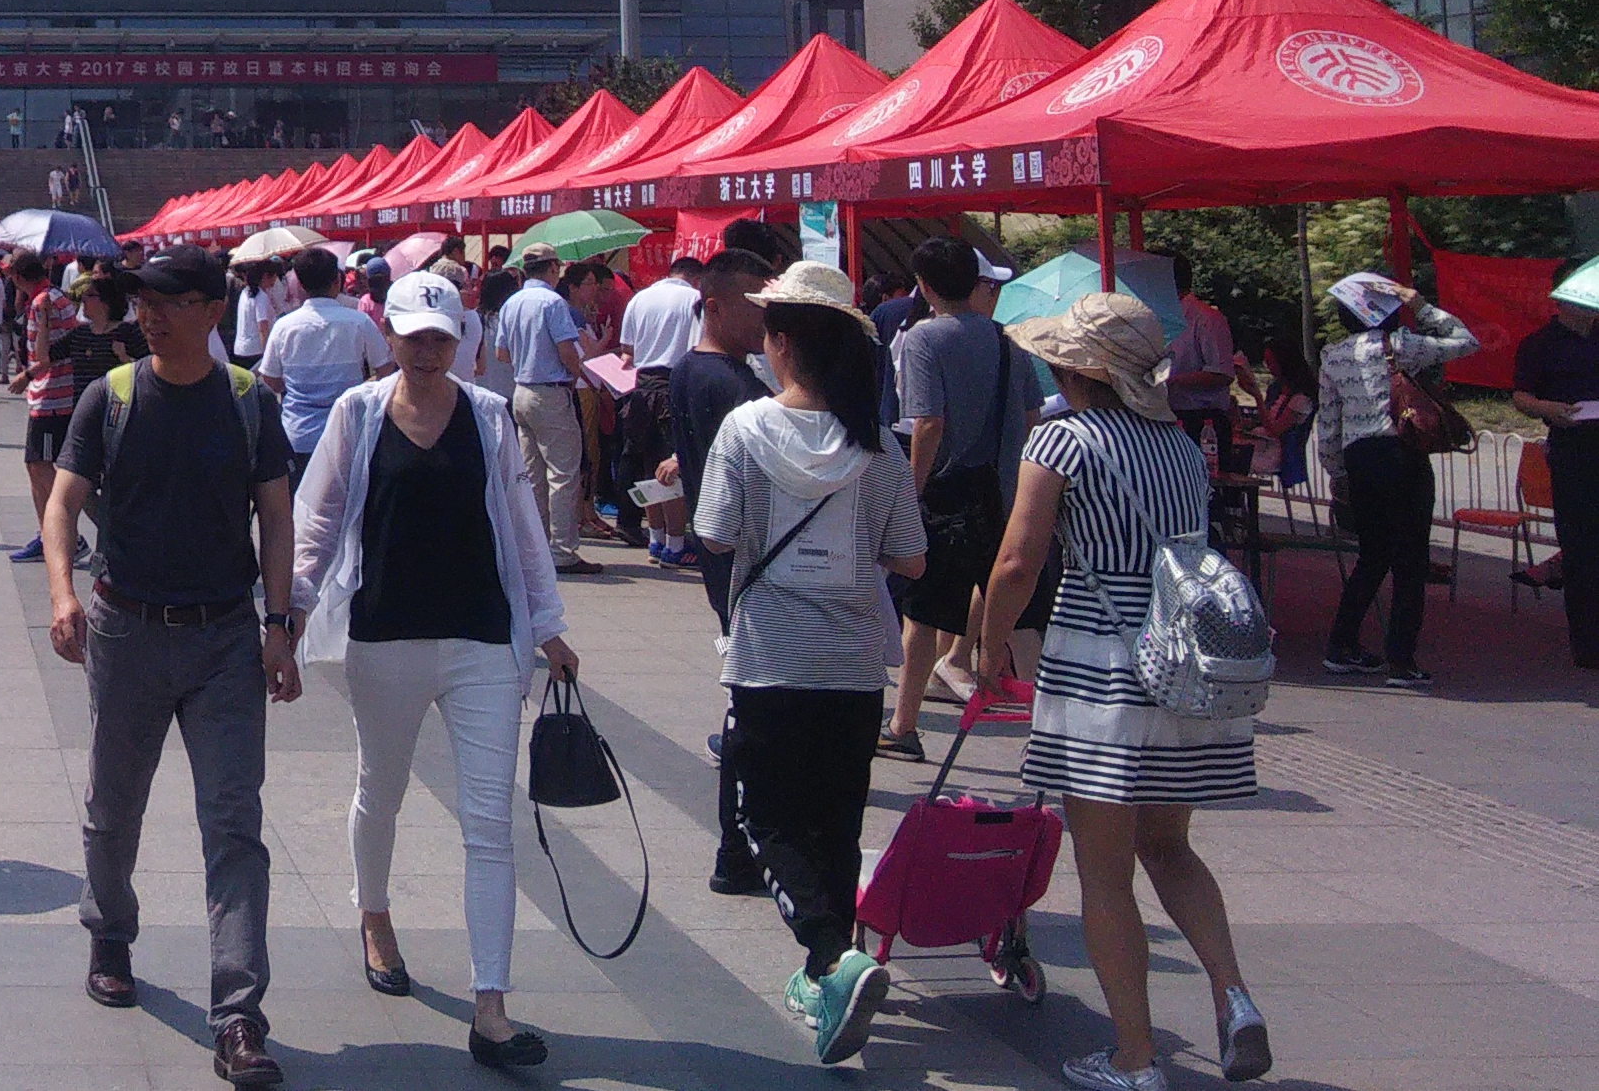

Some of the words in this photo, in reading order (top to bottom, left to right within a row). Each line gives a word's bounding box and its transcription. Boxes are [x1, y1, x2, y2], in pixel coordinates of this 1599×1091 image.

[908, 153, 987, 190] 四川大学
[593, 184, 632, 209] 兰州大学
[719, 172, 775, 201] 浙江大学
[500, 194, 535, 216] 内蒙古大学
